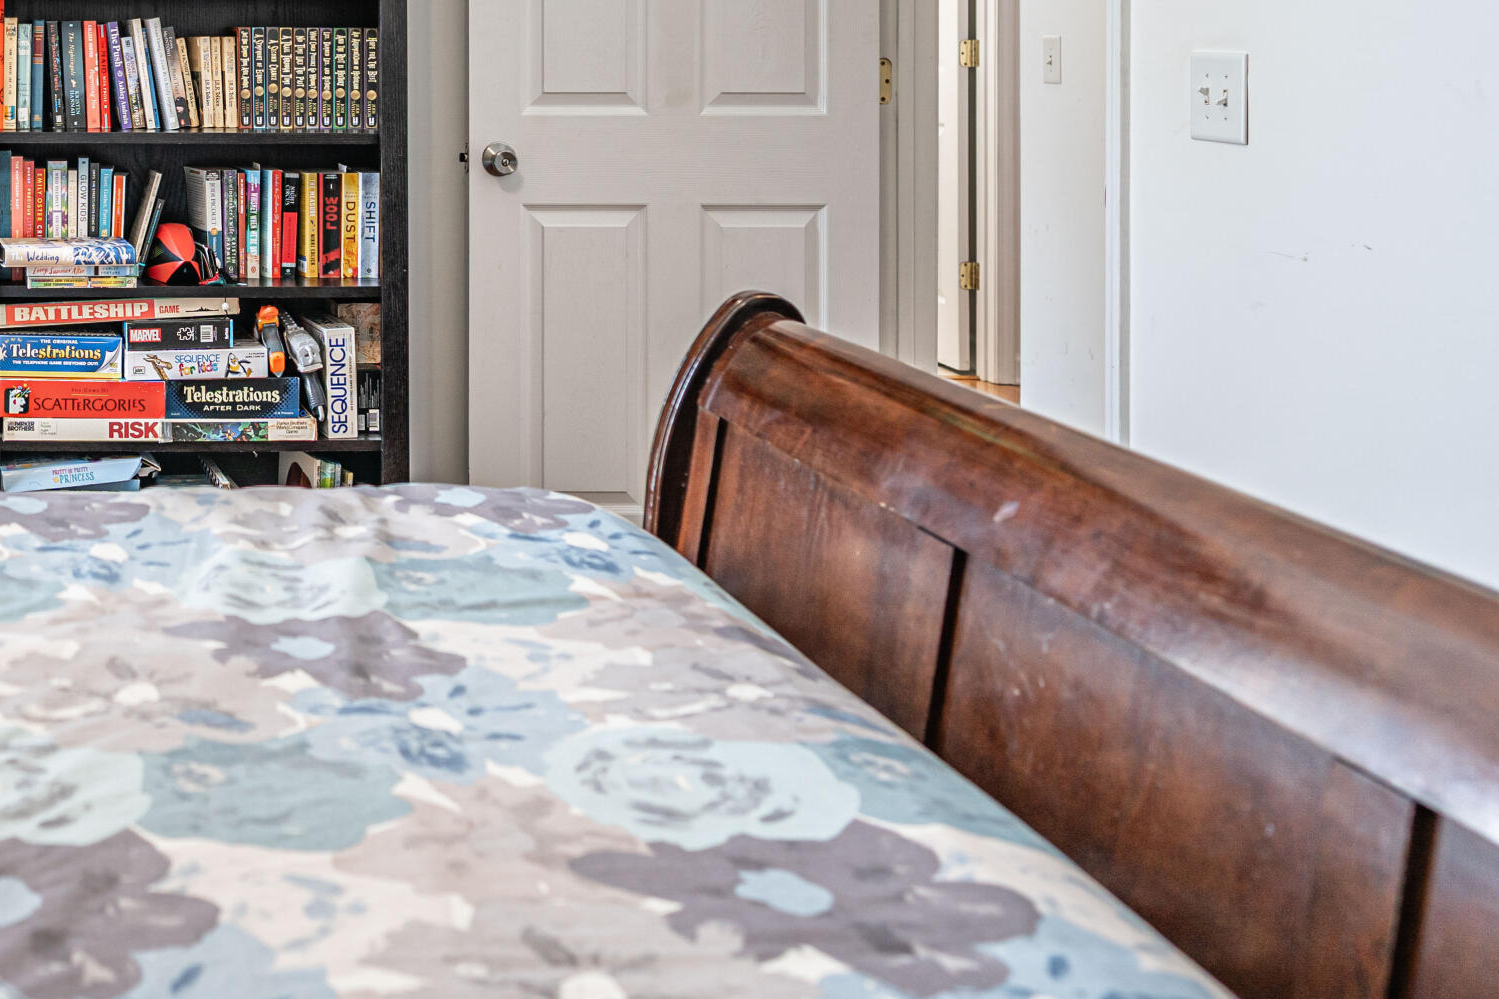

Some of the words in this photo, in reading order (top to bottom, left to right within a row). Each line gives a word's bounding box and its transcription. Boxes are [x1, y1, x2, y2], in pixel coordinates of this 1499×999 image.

[111, 27, 119, 44] The
[68, 45, 76, 76] Nightingale
[346, 201, 356, 242] DUST
[366, 201, 376, 242] SHIFT
[27, 251, 59, 265] Wedding
[14, 303, 148, 321] BATTLESHIP
[159, 305, 180, 313] GAME
[130, 329, 161, 342] MARVEL
[10, 344, 101, 359] Telestrations
[175, 354, 220, 363] SEQUENCE
[179, 363, 196, 376] for
[197, 362, 218, 374] kids
[329, 338, 347, 434] SEQUENCE
[184, 386, 280, 403] Telestrations
[108, 422, 159, 438] RISK
[60, 472, 94, 484] PRINCESS
